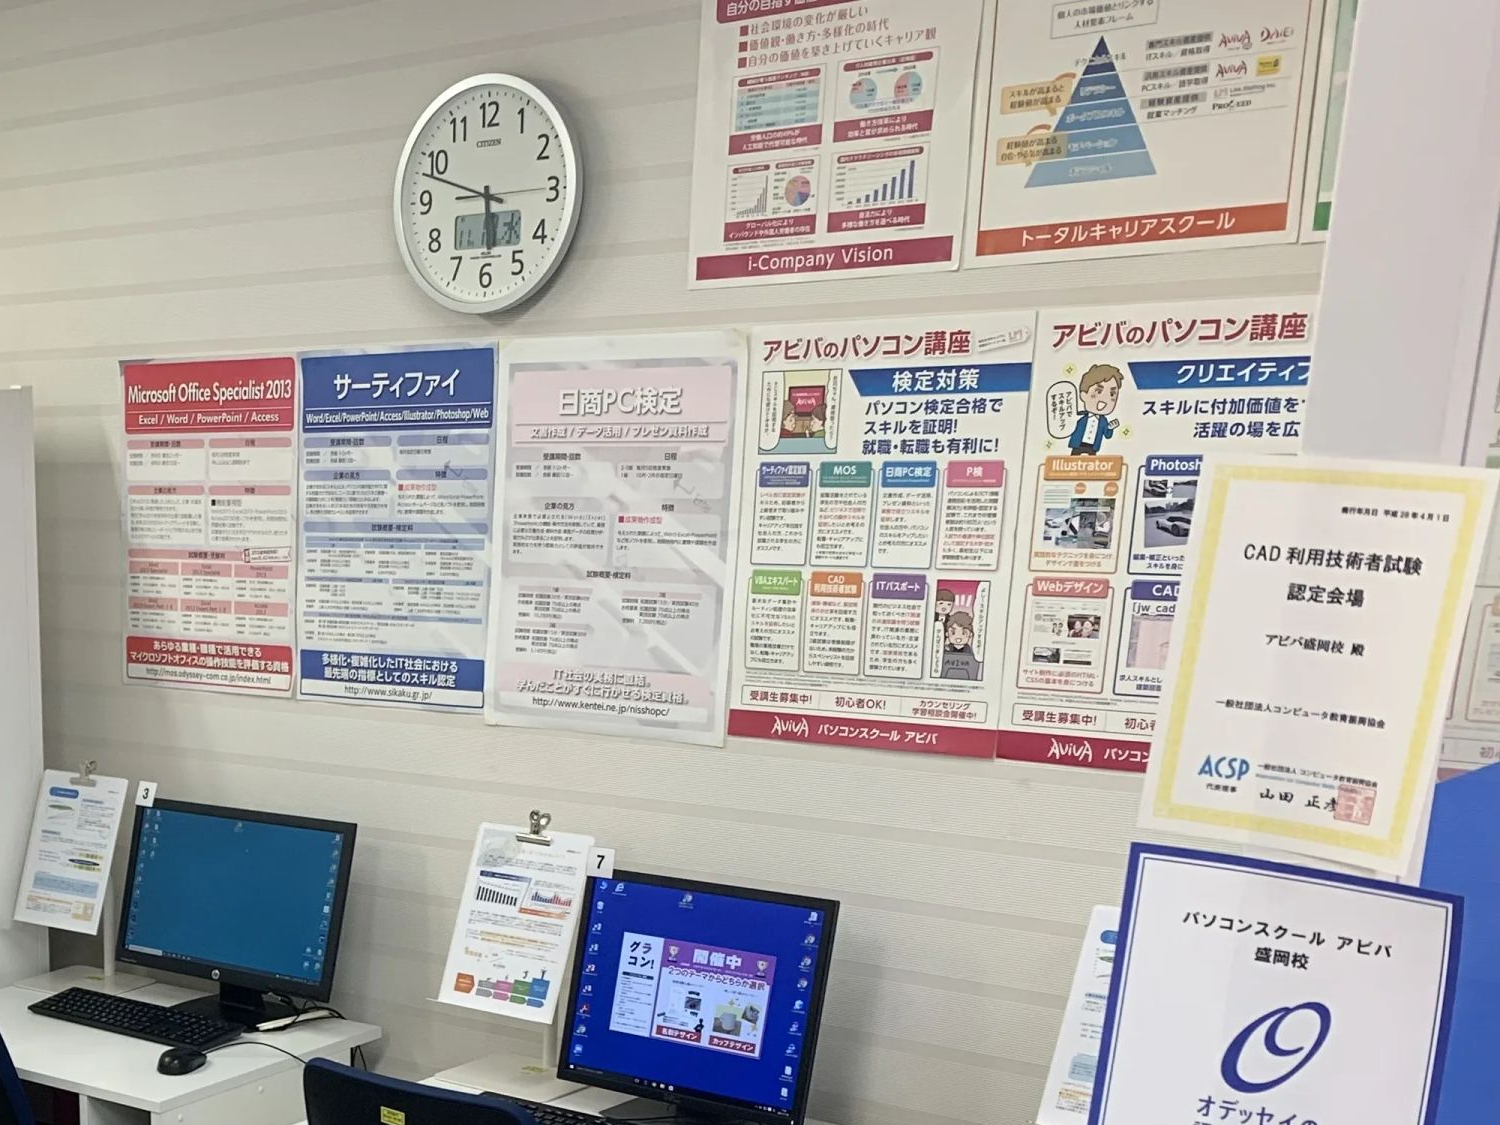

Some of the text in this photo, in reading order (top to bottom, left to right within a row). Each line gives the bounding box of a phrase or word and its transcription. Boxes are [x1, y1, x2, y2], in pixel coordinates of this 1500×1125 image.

[750, 7, 868, 35] 社会環境の変化が厳しい
[748, 28, 937, 67] 自分の価値を築き上げていくキャリア観
[479, 101, 500, 128] 12
[518, 107, 525, 134] 1
[450, 116, 467, 143] 11
[476, 138, 502, 148] CITIZEN
[536, 134, 550, 160] 2
[428, 150, 449, 176] 10
[546, 176, 560, 202] 3
[419, 190, 433, 215] 9
[428, 228, 442, 253] 8
[532, 218, 548, 244] 4
[1021, 212, 1235, 247] トータルキャリアスクール
[450, 256, 463, 281] 7
[511, 250, 524, 276] 5
[748, 246, 893, 272] i-Company Vision
[479, 263, 492, 288] 6
[1052, 313, 1308, 349] アビバのパソコン講座
[763, 330, 971, 361] アビバのパソコン講座
[128, 379, 291, 405] Microsoft Office Specialist 2013
[334, 369, 461, 400] サーティファイ
[892, 368, 980, 392] 検定対策
[559, 386, 683, 416] 日商PC検定
[865, 397, 1003, 416] パソコン検定合格で
[1142, 398, 1306, 416] スキルに付加価値を
[139, 412, 279, 425] Excel Word PowerPoint Access
[864, 419, 958, 435] スキルを証明!
[862, 438, 999, 456] 就職・転職も有利に!
[833, 466, 857, 475] MOS
[885, 466, 932, 477] 日商PC検定
[966, 466, 983, 477] P検
[1052, 459, 1114, 472] Illustrator
[1243, 543, 1423, 576] CAD 利用技術者試験
[876, 582, 920, 592] ITパスポート
[1037, 581, 1104, 593] Webデザイン
[1287, 583, 1364, 607] 認定会場
[1265, 634, 1344, 654] アビバ盛岡校
[344, 686, 432, 700] http://www.sikaku.gr.jp/
[750, 690, 812, 704] 受講生募集中!
[835, 696, 886, 710] 初心者OK!
[920, 700, 970, 710] カウンセリング
[533, 697, 670, 717] http://www.kentei.ne.jp/nisshopc/
[1022, 709, 1097, 726] 受講生募集中!
[818, 724, 900, 742] パソコンスクール
[905, 731, 938, 746] アビバ
[1198, 755, 1250, 781] ACSP
[142, 787, 150, 799] 3
[1259, 788, 1294, 803] 山田
[596, 854, 606, 870] 7
[1182, 910, 1393, 958] パソコンスクール アビバ
[630, 941, 652, 955] グラ
[1254, 947, 1309, 971] 盛岡校
[628, 955, 655, 969] コン!
[668, 967, 766, 991] 2つのテーマからどちらか選択
